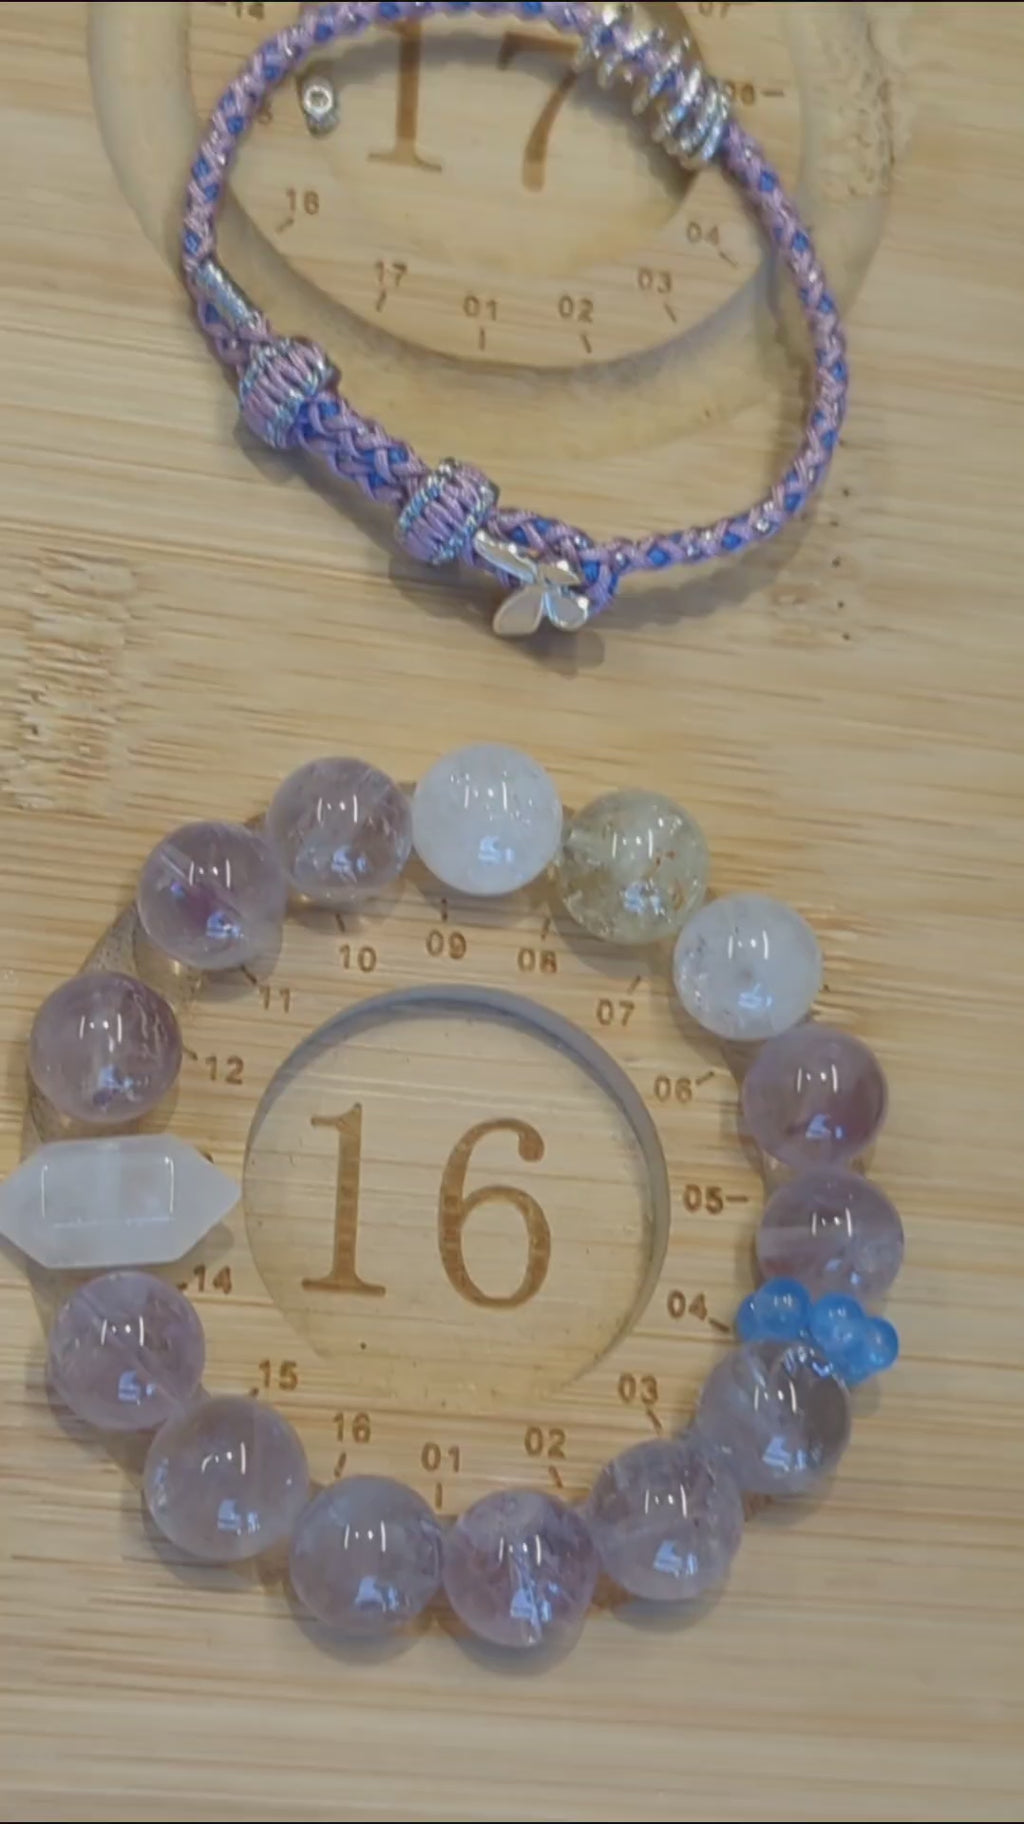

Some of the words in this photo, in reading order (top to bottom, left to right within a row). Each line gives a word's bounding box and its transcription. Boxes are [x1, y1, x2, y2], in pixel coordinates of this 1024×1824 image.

[367, 15, 580, 192] 17
[285, 188, 320, 216] 16
[686, 221, 720, 246] 04
[375, 260, 408, 286] 17
[638, 268, 673, 294] 03
[463, 295, 498, 321] 01
[558, 295, 594, 323] 02
[339, 944, 377, 973] 10
[425, 929, 467, 960] 09
[258, 985, 291, 1013] 11
[596, 998, 635, 1027] 07
[205, 1055, 244, 1085] 12
[653, 1074, 693, 1103] 06
[302, 1101, 552, 1310] 16
[683, 1183, 724, 1216] 05
[193, 1264, 232, 1294] 14
[666, 1289, 708, 1320] 04
[259, 1359, 298, 1391] 15
[617, 1372, 658, 1405] 03
[333, 1411, 371, 1444] 16
[421, 1442, 460, 1473] 01
[524, 1426, 566, 1460] 02
